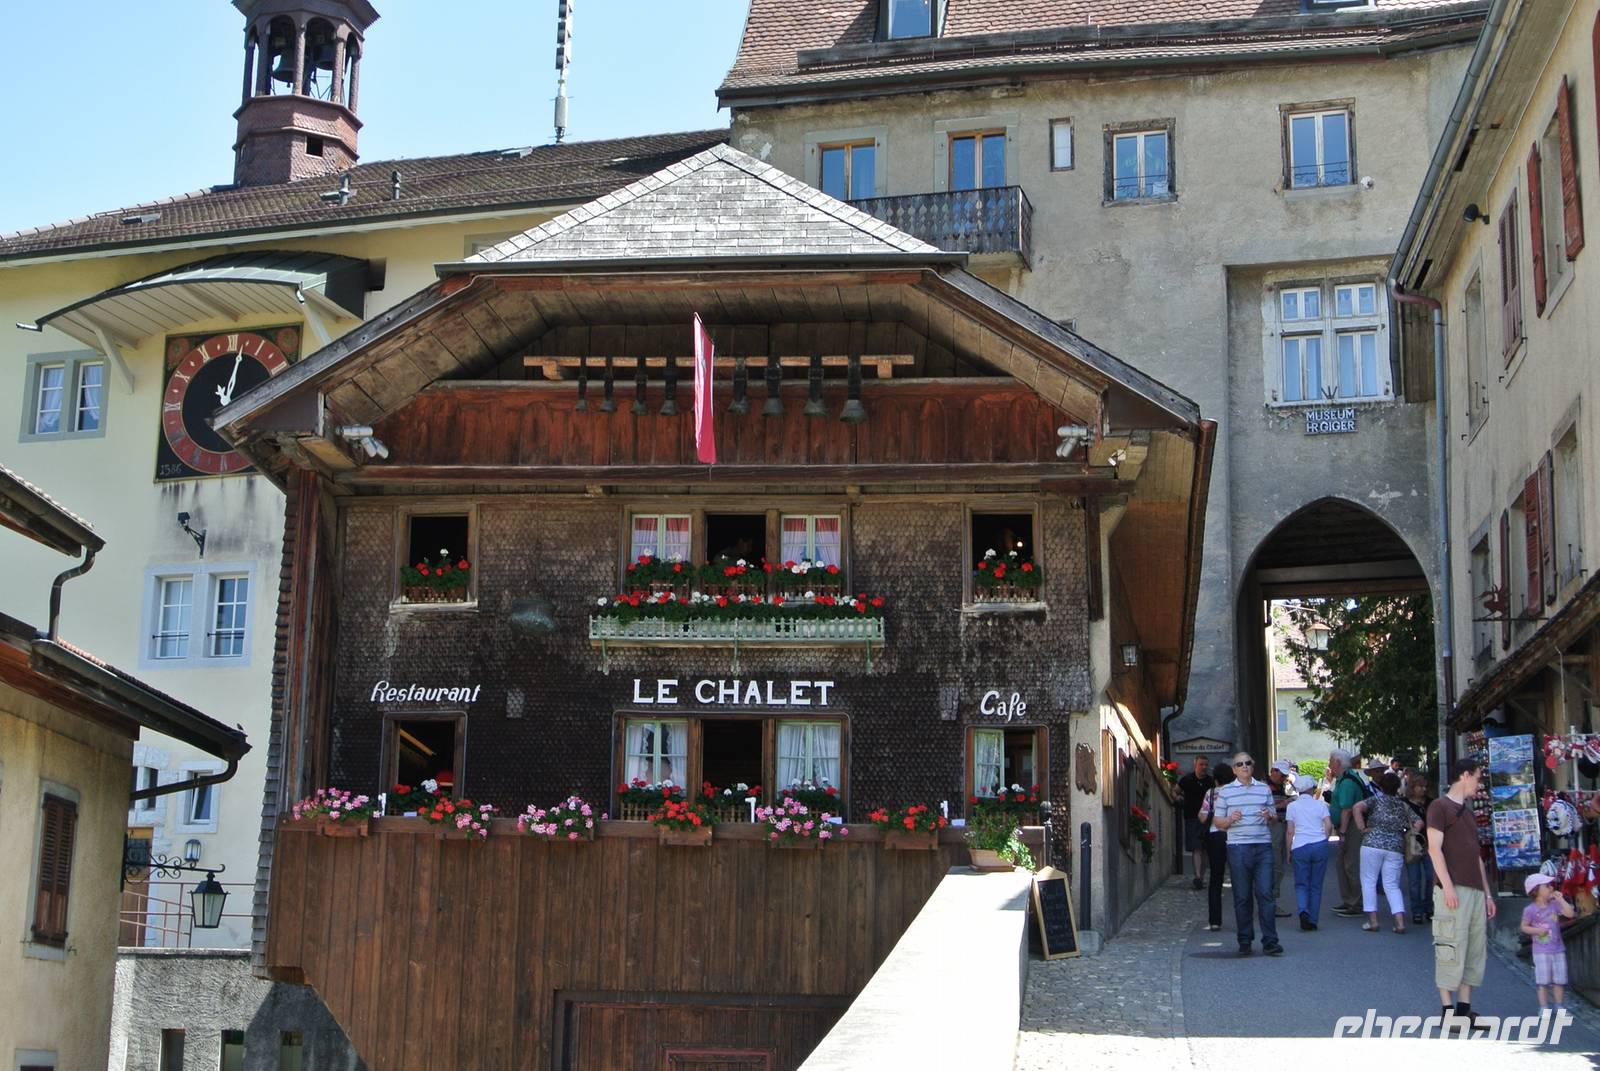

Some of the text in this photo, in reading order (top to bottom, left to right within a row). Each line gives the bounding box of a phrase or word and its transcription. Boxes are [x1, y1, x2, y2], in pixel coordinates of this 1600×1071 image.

[1306, 408, 1355, 421] MUSEUM
[1320, 420, 1355, 432] GIGER
[370, 680, 481, 703] Restaurant
[633, 679, 834, 706] LE CHALET
[980, 690, 1027, 722] Cafe
